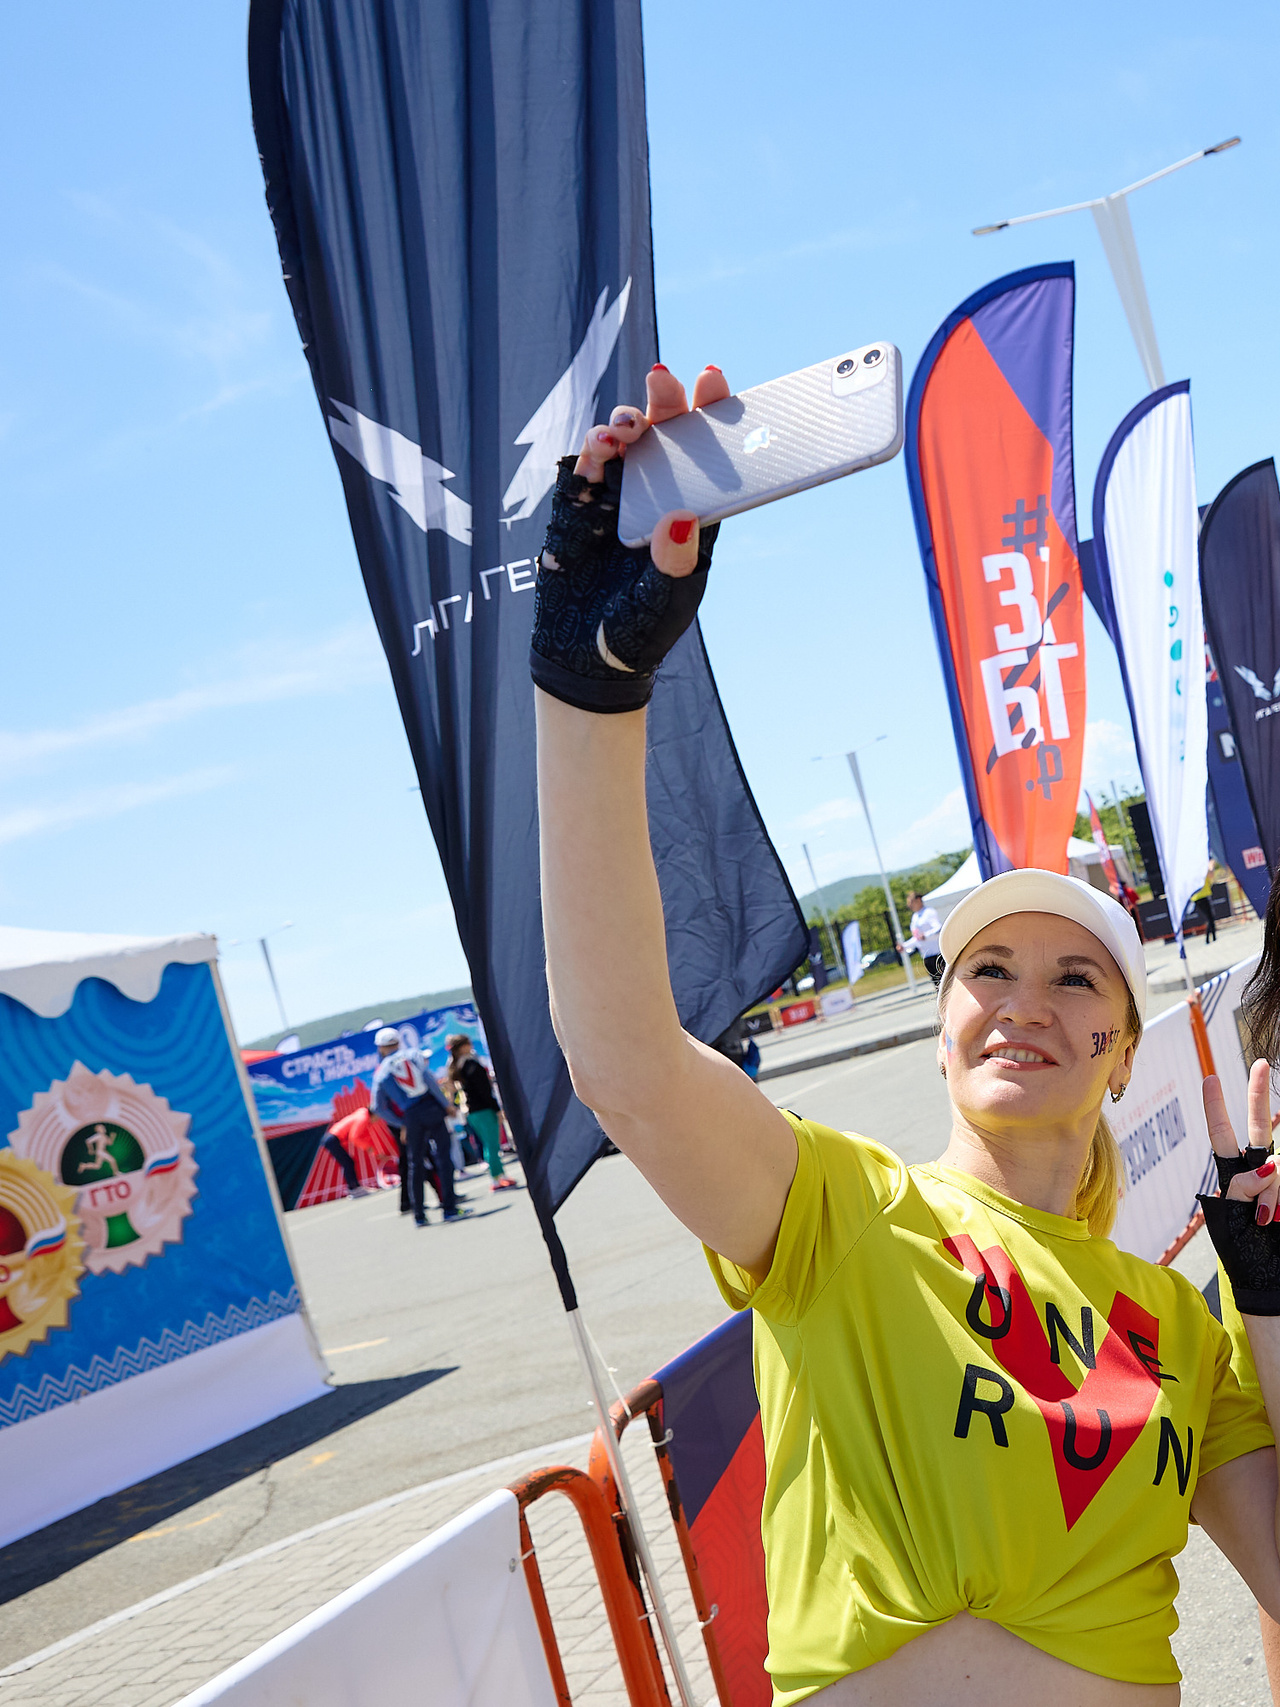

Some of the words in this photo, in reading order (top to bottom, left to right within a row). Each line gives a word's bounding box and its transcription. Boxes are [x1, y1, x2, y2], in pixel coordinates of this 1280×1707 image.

[90, 1181, 131, 1207] ГТО
[966, 1272, 1179, 1383] ONE
[954, 1363, 1193, 1496] RUN
